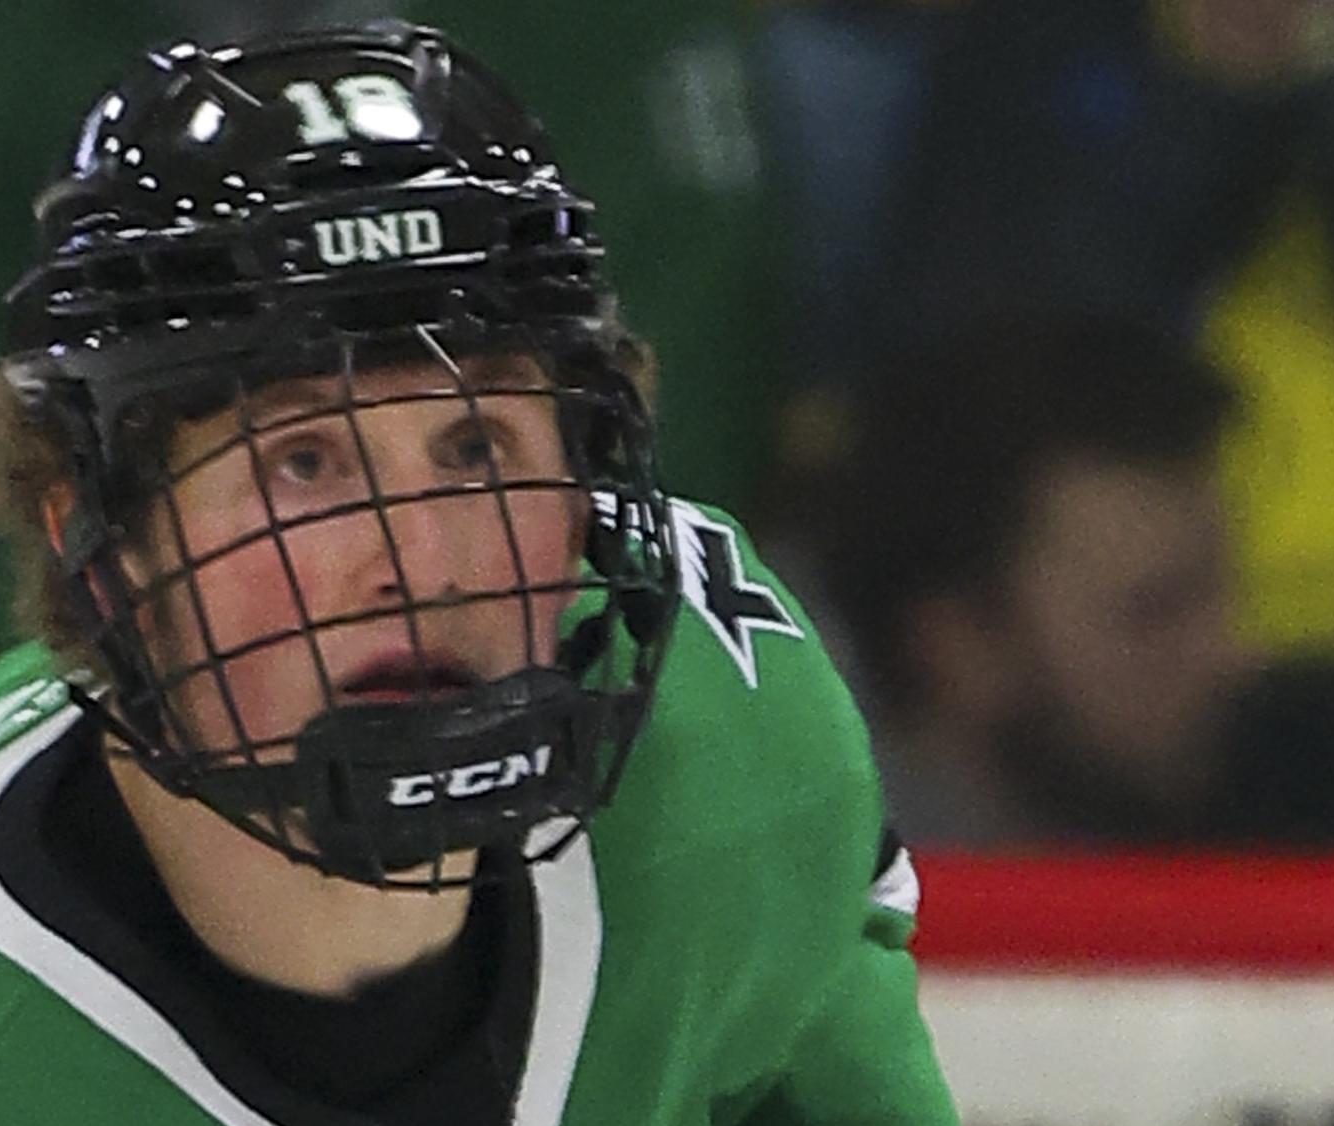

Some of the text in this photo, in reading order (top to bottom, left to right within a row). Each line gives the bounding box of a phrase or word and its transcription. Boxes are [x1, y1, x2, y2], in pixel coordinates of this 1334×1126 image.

[283, 74, 422, 144] 18
[314, 210, 444, 265] UND
[389, 744, 552, 806] CCM
